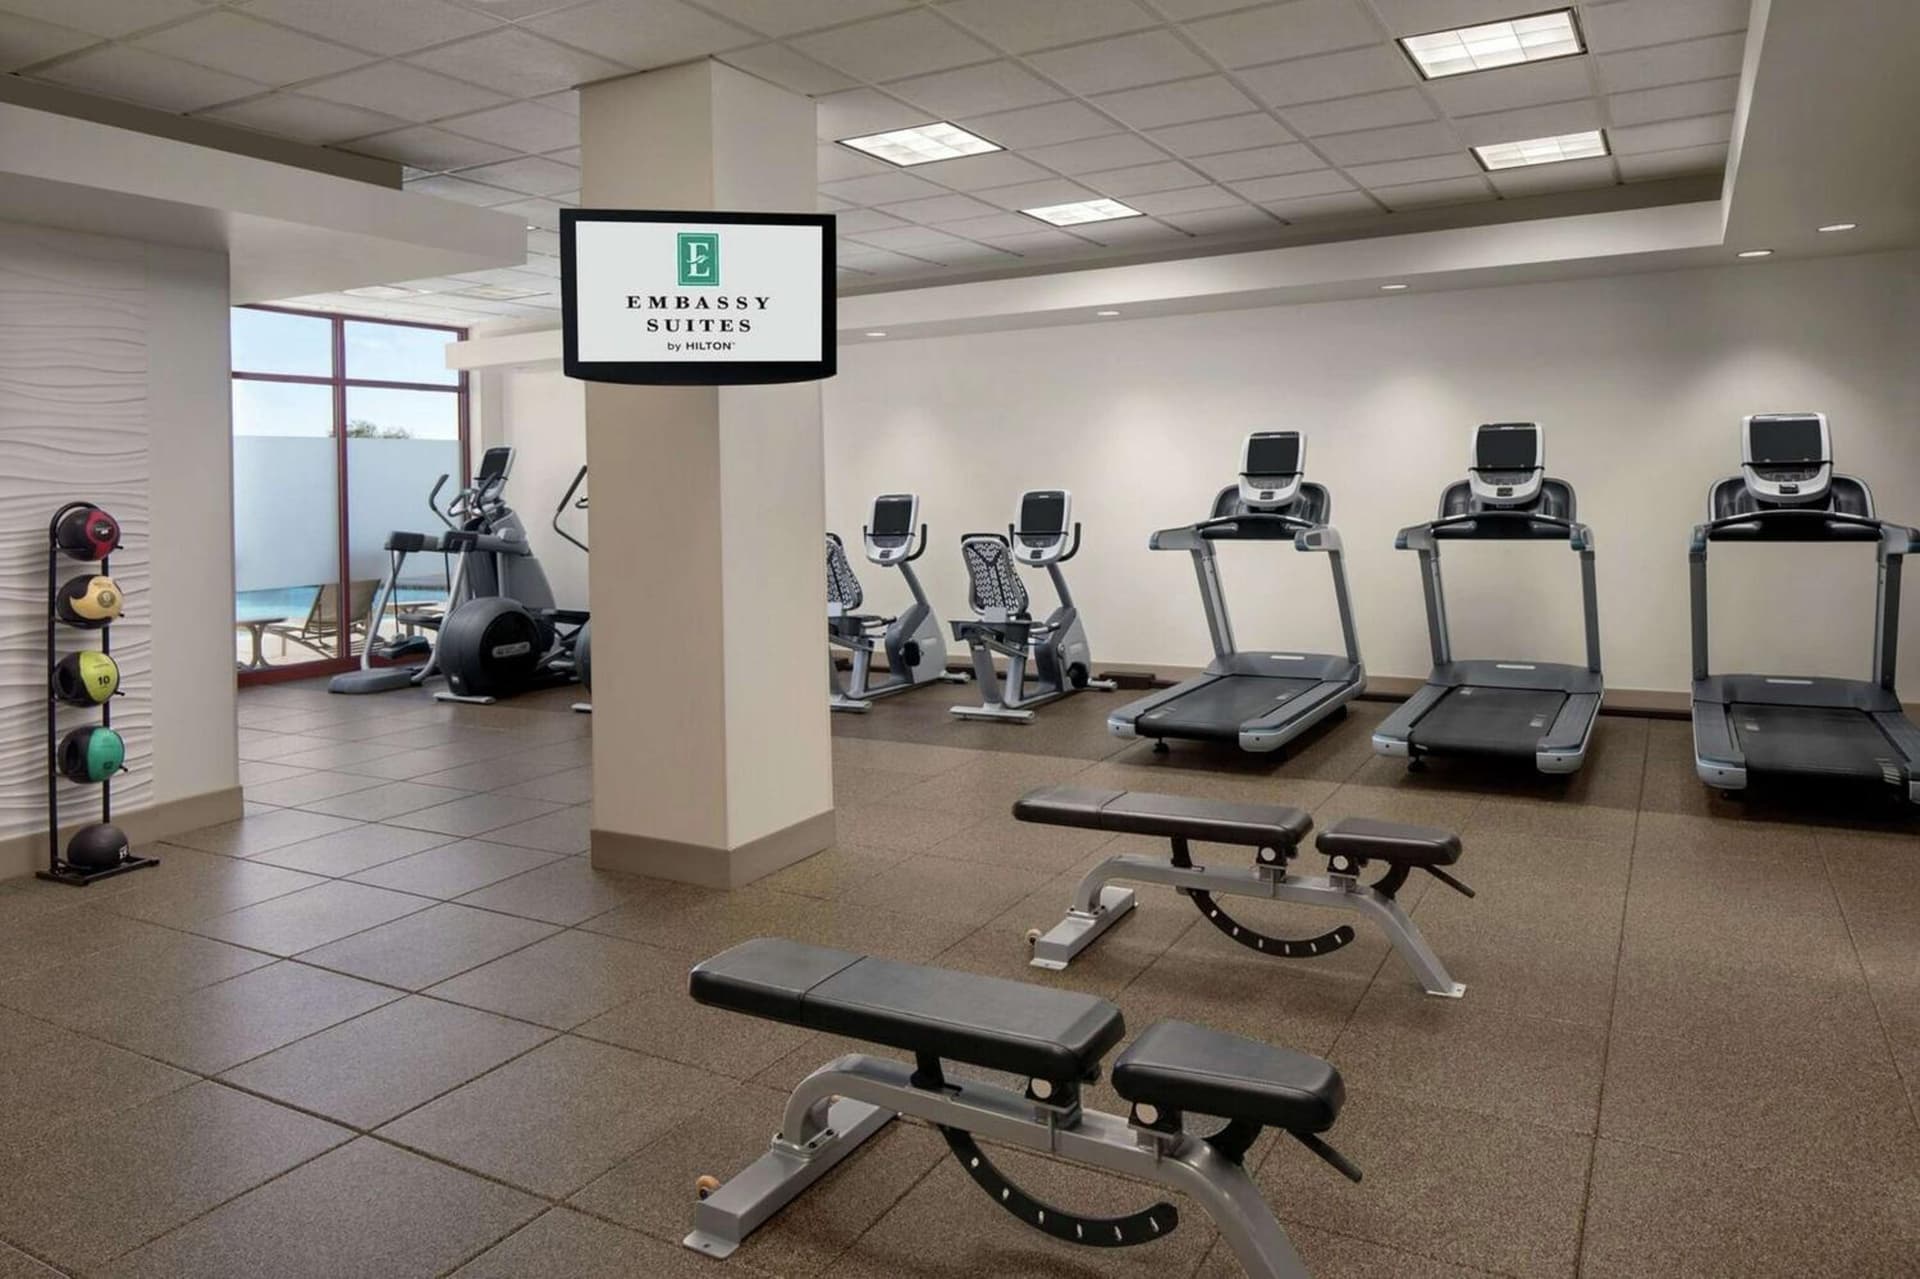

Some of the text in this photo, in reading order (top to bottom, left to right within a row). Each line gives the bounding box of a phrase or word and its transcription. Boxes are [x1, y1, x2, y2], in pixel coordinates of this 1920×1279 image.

[686, 241, 710, 277] E
[626, 295, 770, 310] EMBASSY
[646, 318, 752, 333] SUITES
[667, 341, 732, 352] by HILTON
[98, 675, 110, 686] 10
